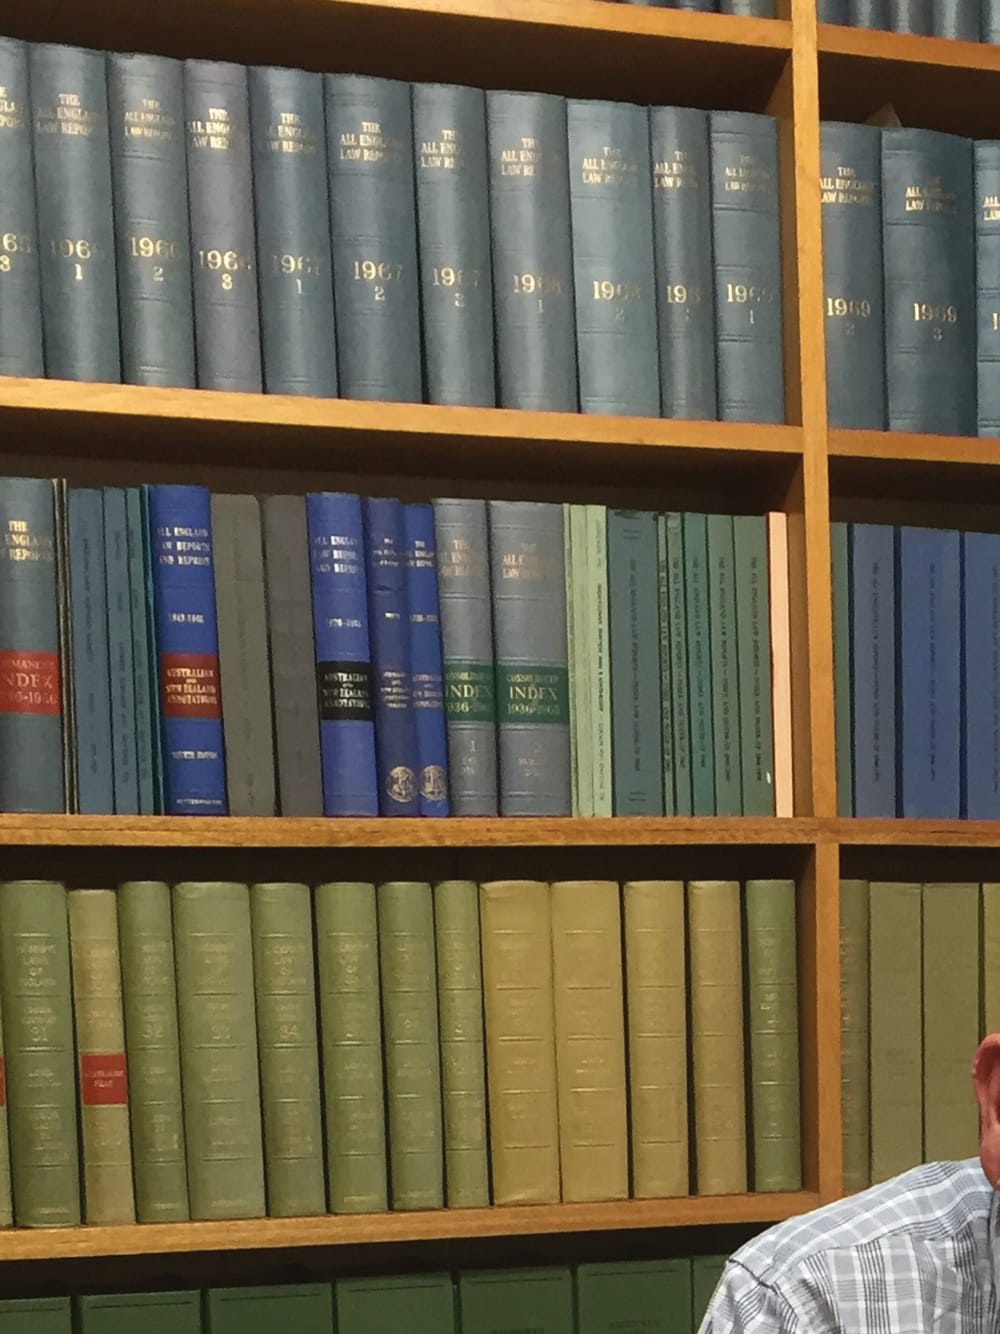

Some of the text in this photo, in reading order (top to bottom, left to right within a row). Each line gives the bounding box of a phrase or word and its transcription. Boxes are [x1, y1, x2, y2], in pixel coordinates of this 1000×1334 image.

[339, 134, 357, 146] ALL
[339, 148, 361, 160] LAW
[421, 142, 439, 154] ALL
[421, 156, 441, 167] LAW
[501, 151, 518, 163] ALL
[582, 158, 600, 170] ALL
[905, 186, 922, 197] ALL
[74, 264, 83, 280] 1
[296, 279, 303, 294] 1
[374, 286, 385, 301] 2
[509, 686, 558, 700] INDEX
